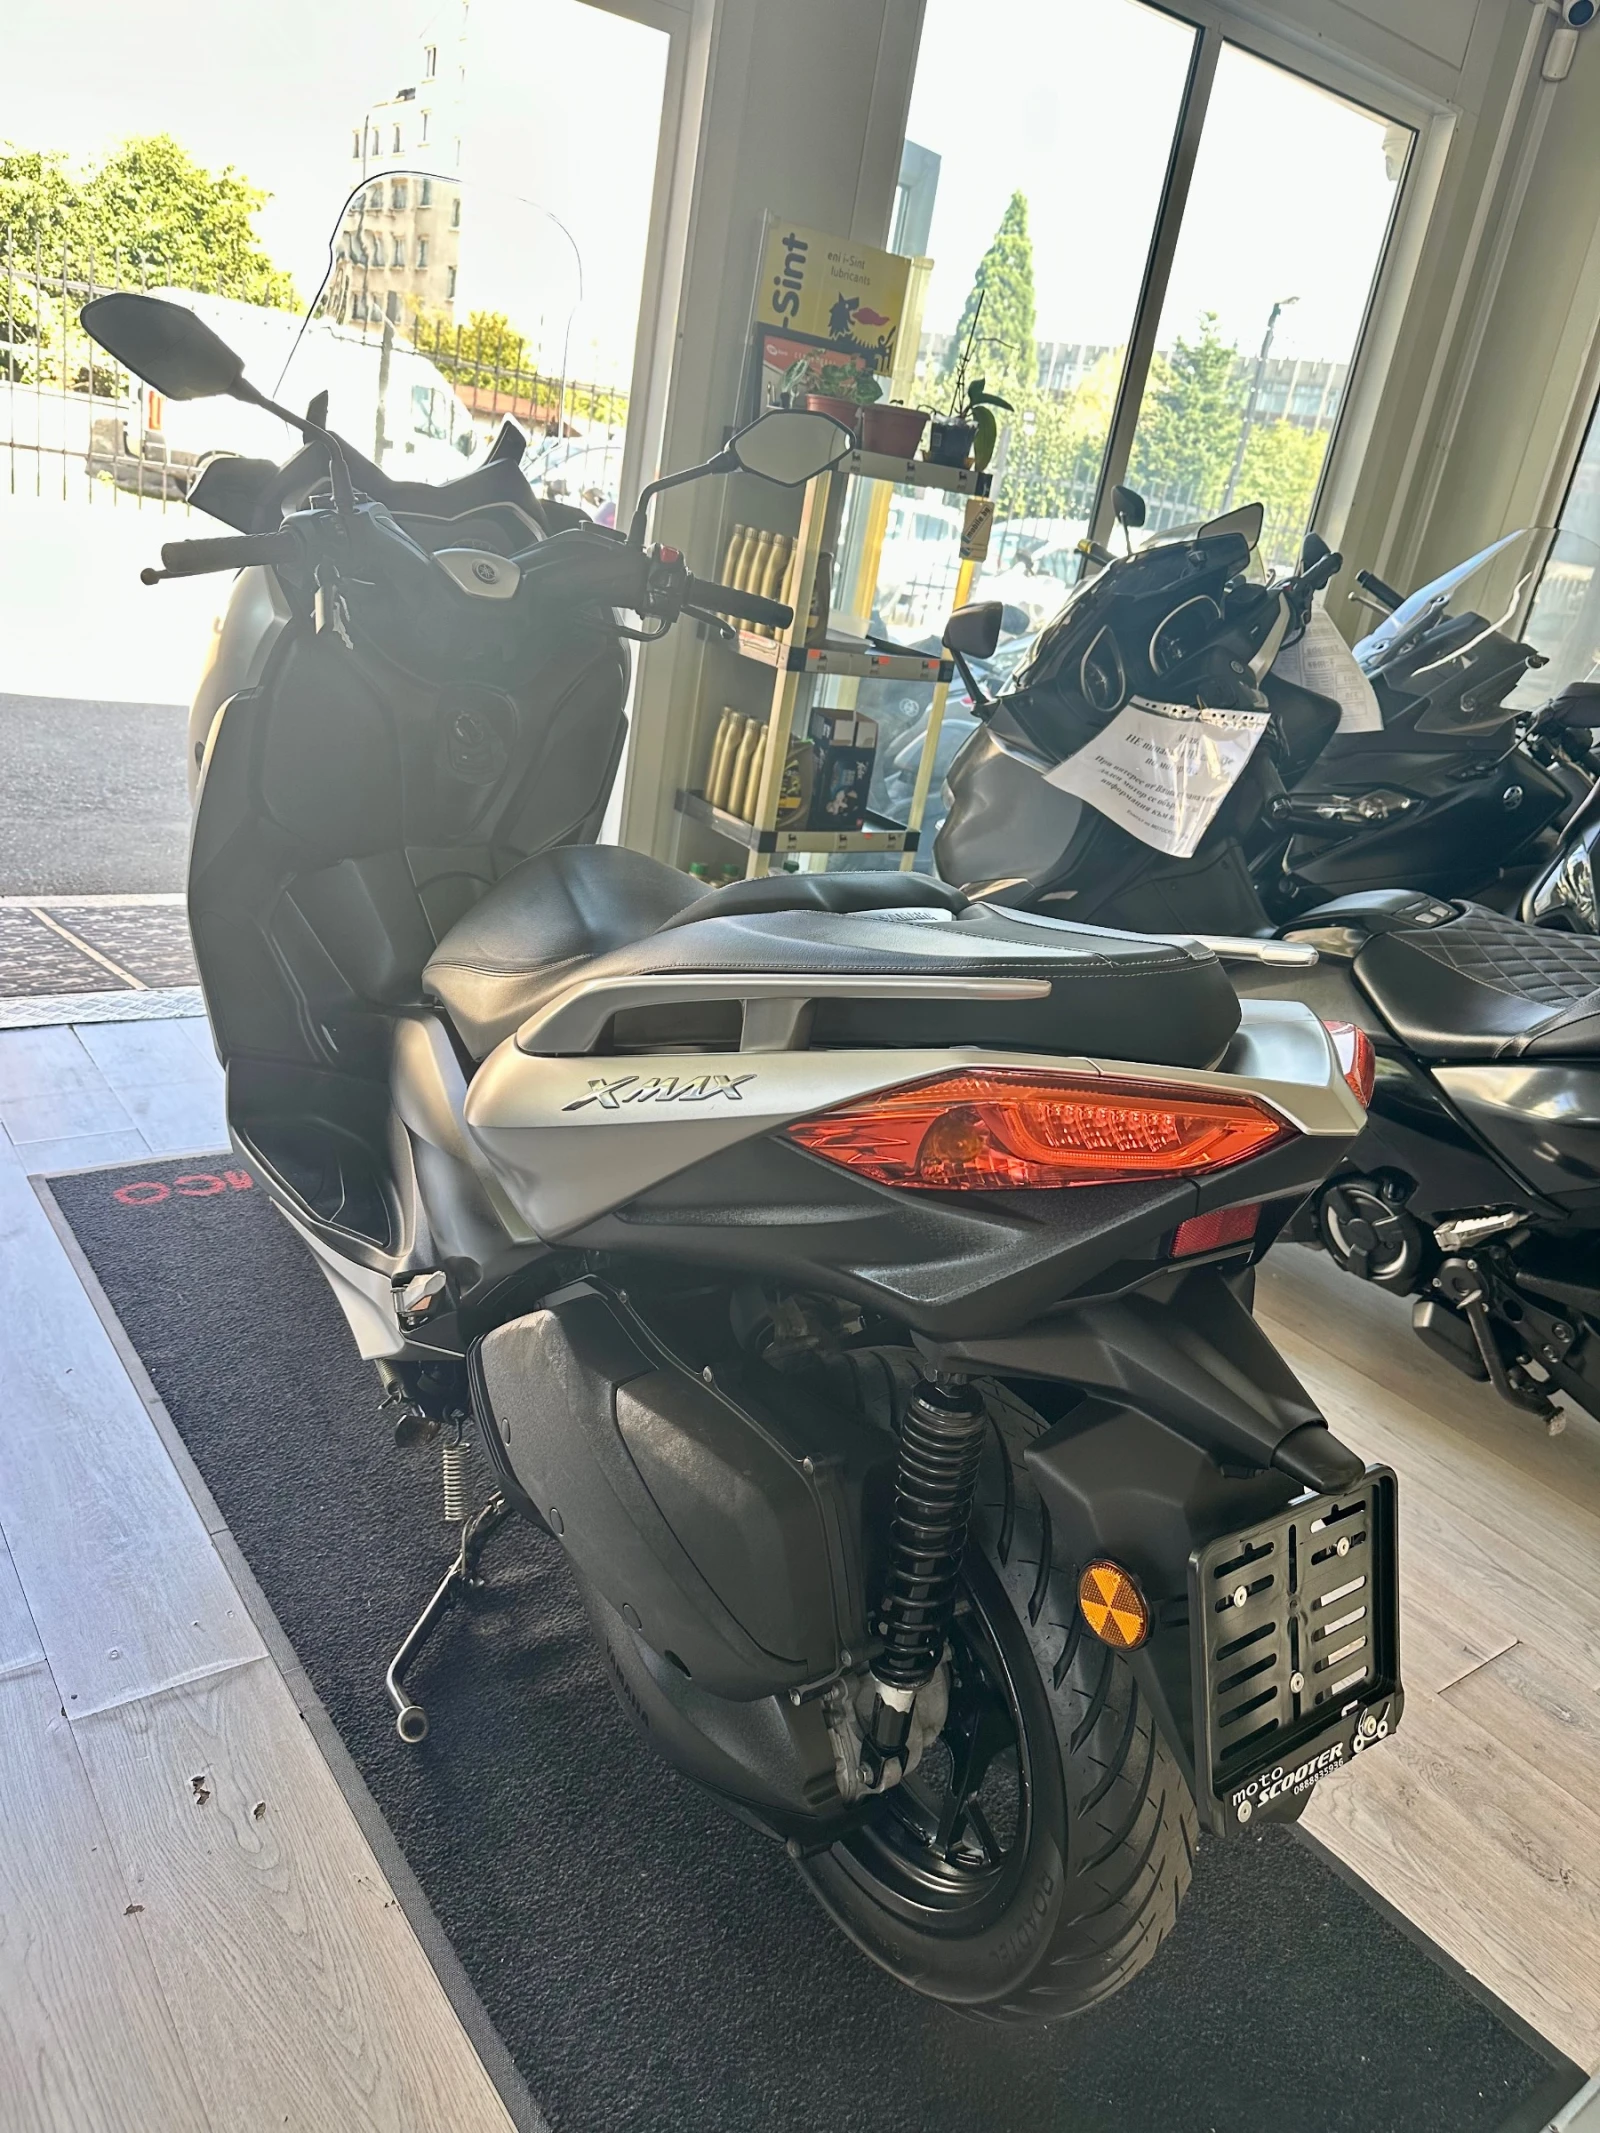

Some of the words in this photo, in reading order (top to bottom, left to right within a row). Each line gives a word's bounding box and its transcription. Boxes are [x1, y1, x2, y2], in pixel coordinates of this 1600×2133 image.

[830, 266, 871, 287] lubricants
[561, 1074, 758, 1111] XMAX
[1232, 1766, 1284, 1807] moto
[1256, 1741, 1344, 1808] SCOOTER
[1293, 1757, 1344, 1796] 0888835936
[988, 1871, 1054, 1966] ROADTEC
